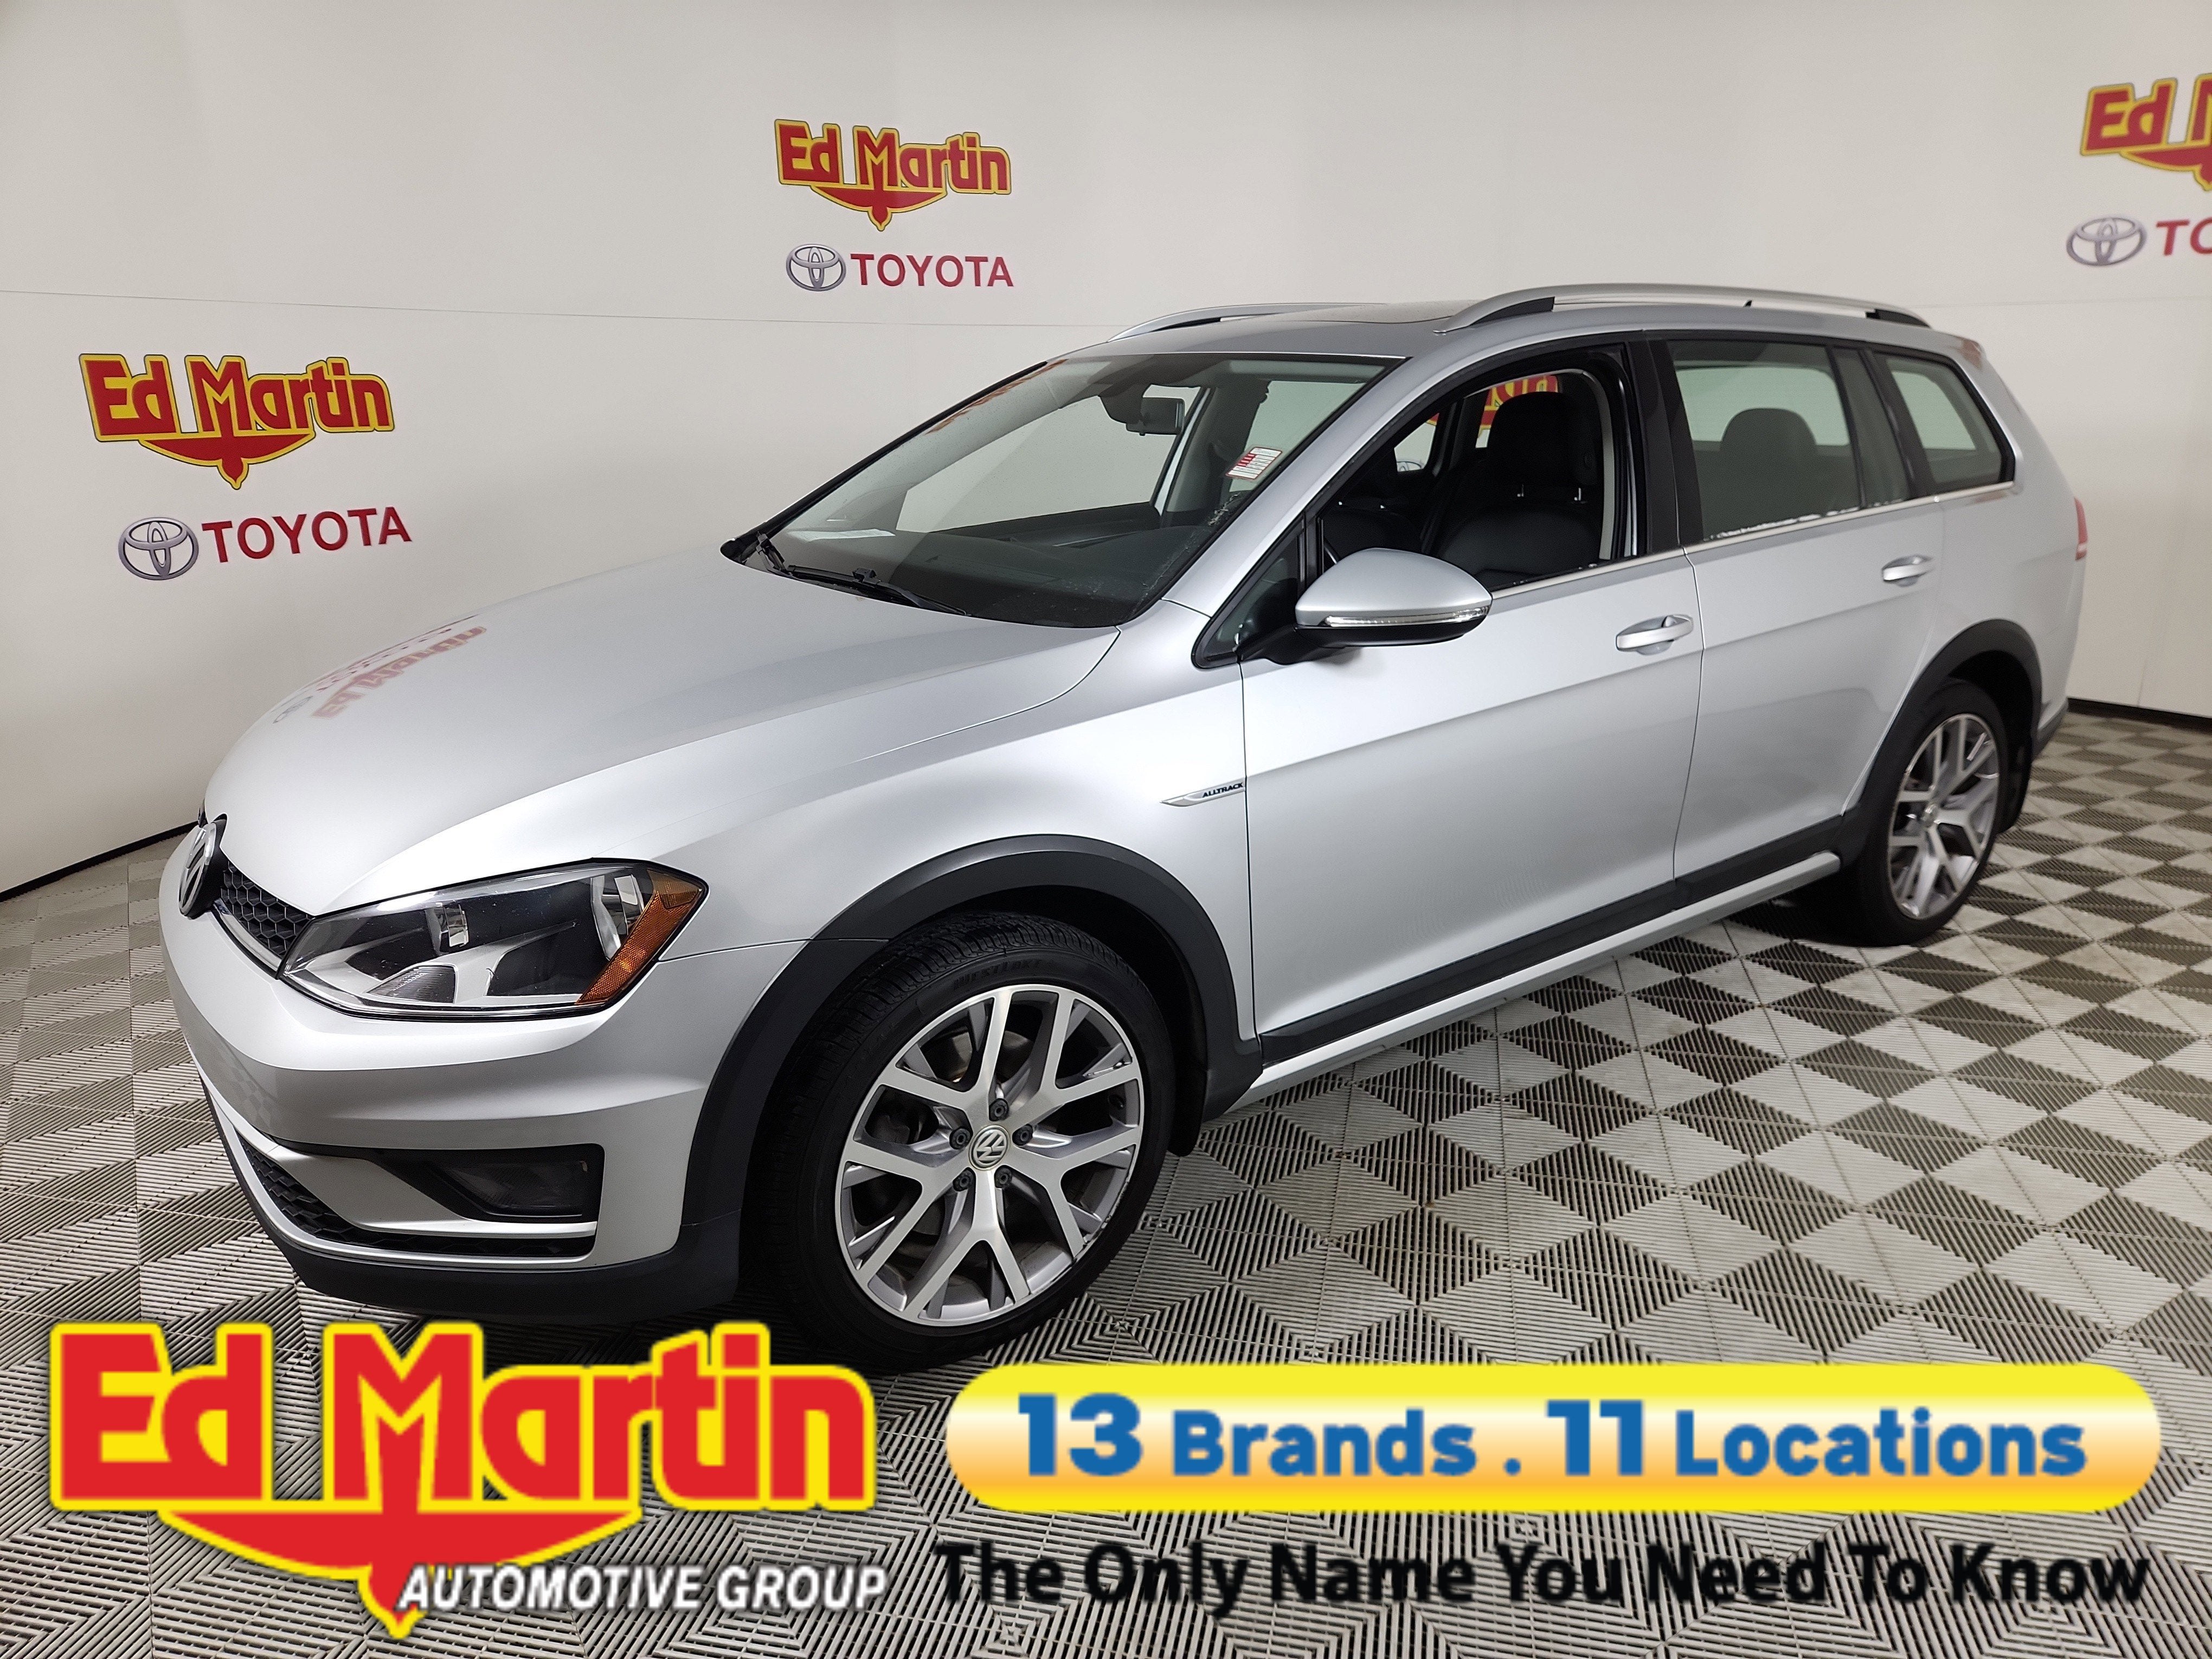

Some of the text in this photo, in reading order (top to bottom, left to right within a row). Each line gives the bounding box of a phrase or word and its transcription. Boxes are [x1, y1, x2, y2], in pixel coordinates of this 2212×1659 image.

[2084, 81, 2175, 153] Ed
[776, 121, 1009, 192] Ed Martin
[851, 253, 1014, 287] TOYOTA
[82, 356, 392, 438] Ed Martin
[202, 506, 412, 563] TOYOTA
[1202, 782, 1243, 798] ALLTRACK
